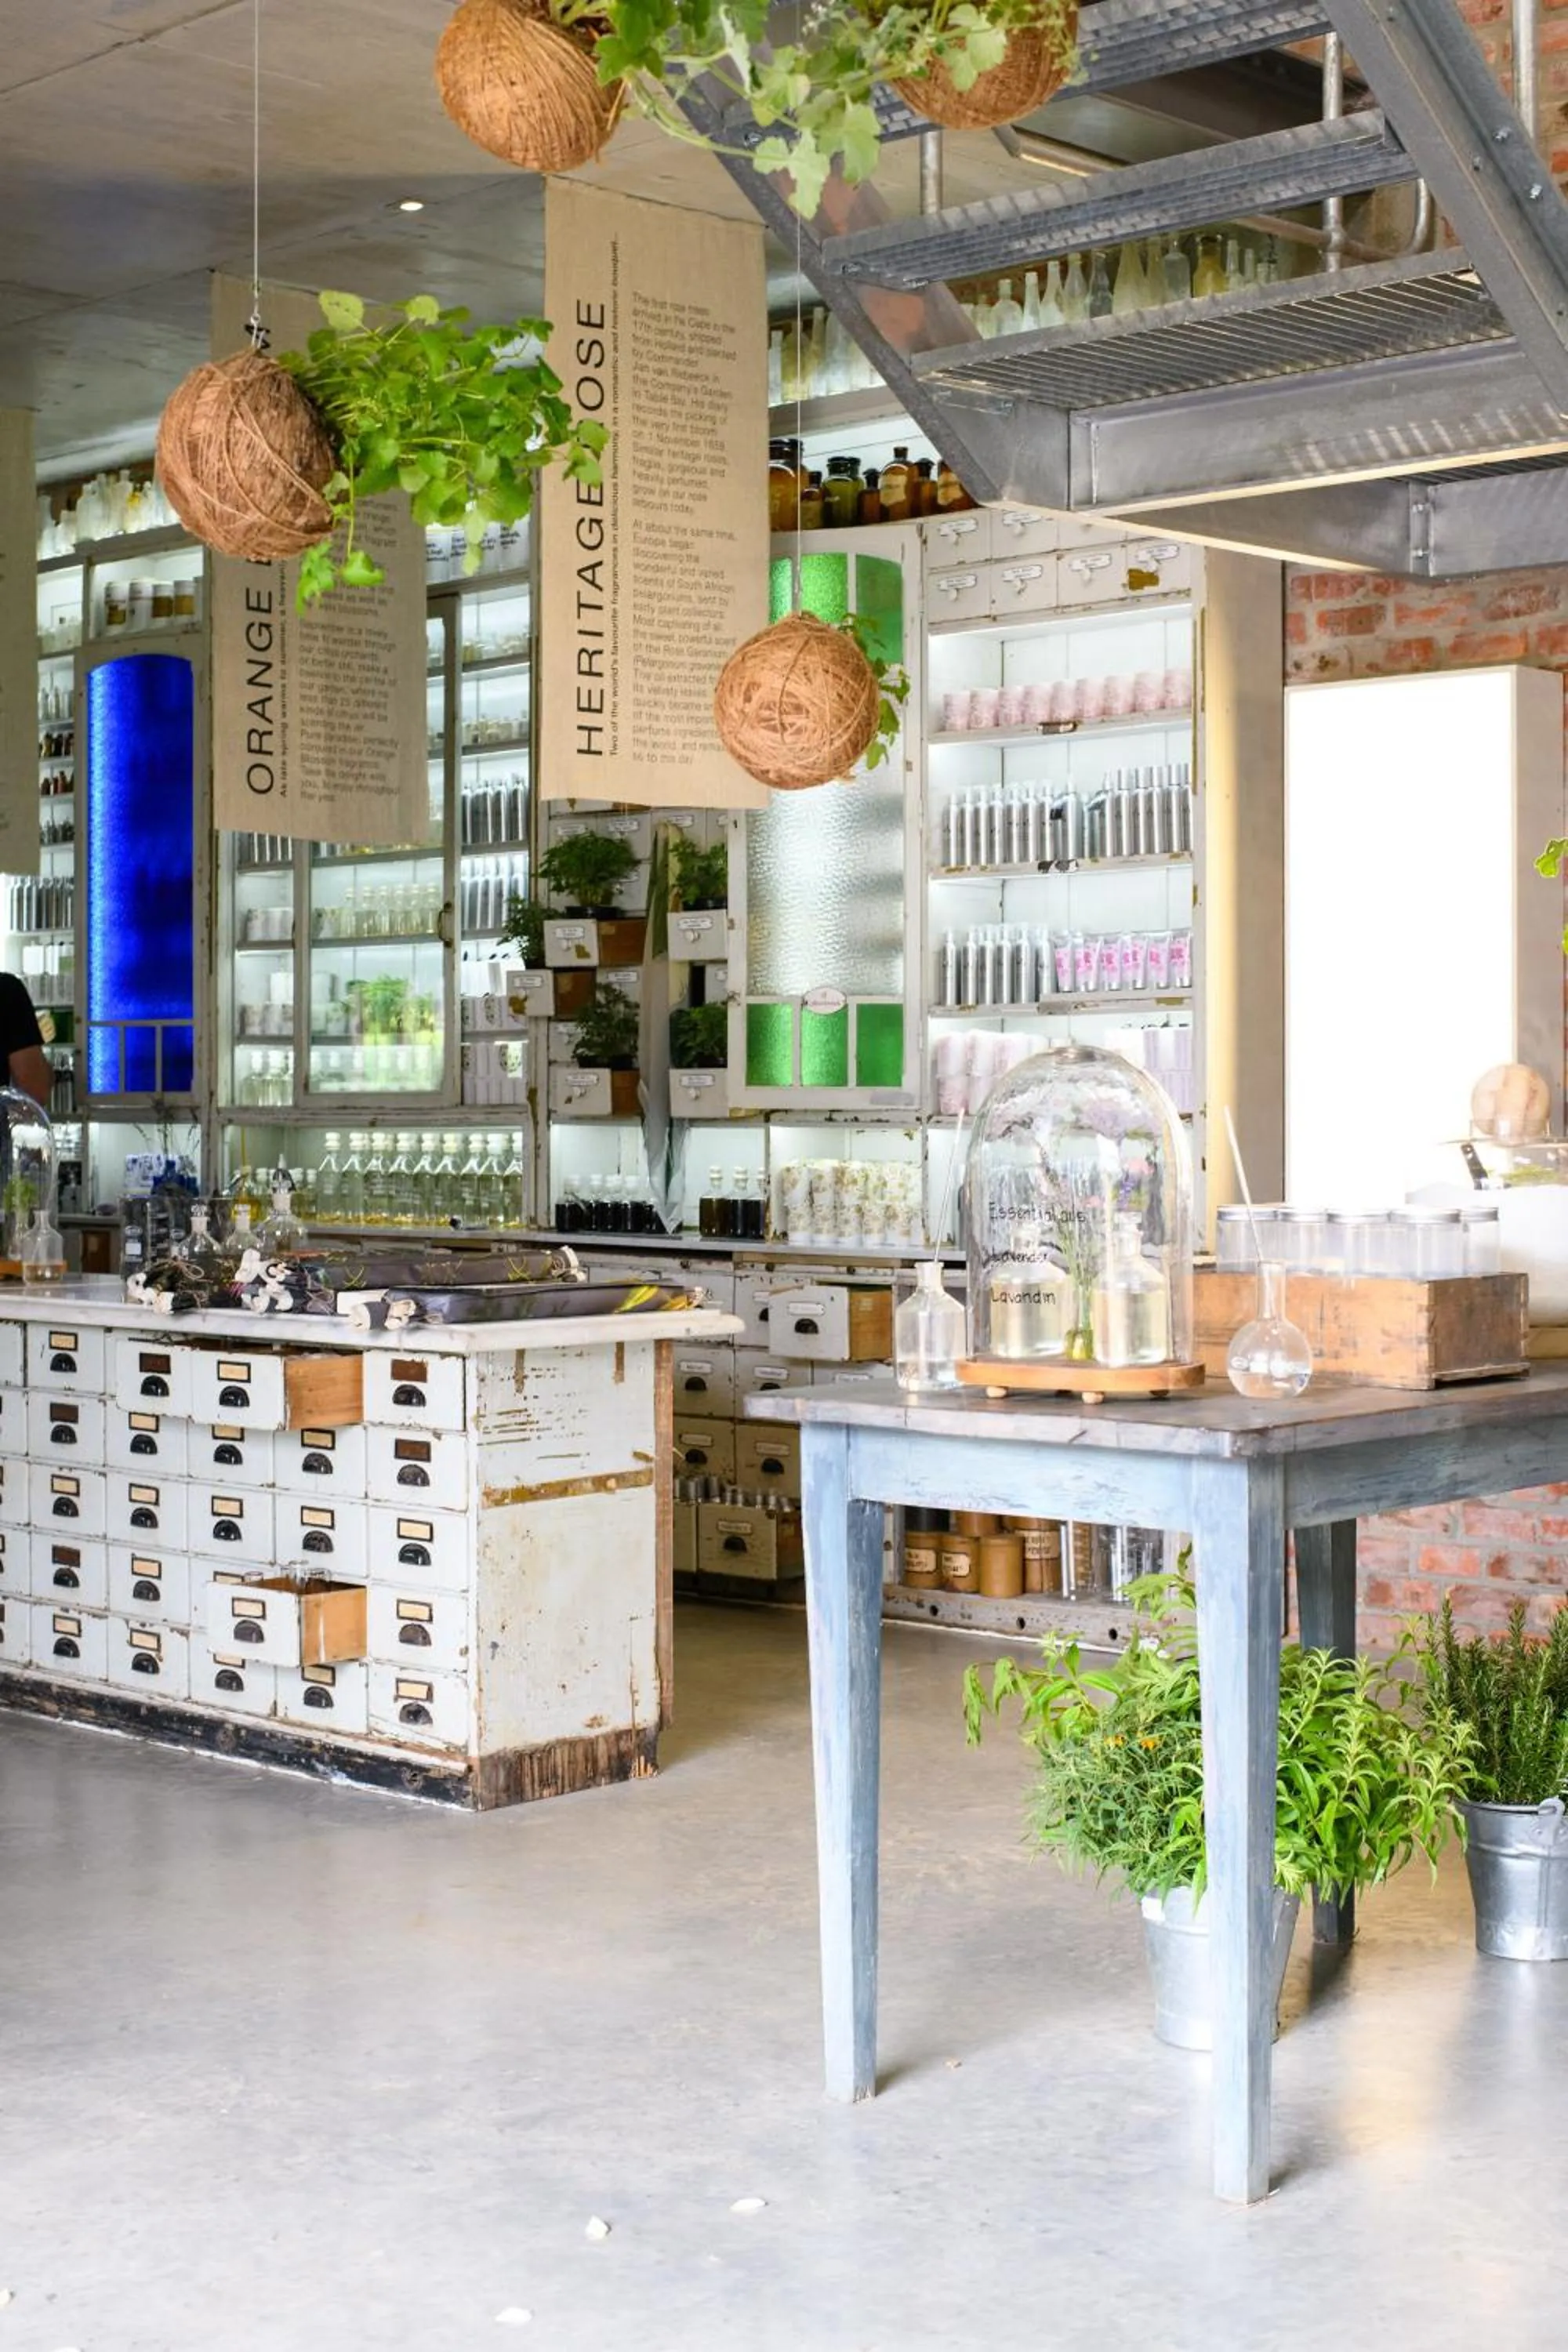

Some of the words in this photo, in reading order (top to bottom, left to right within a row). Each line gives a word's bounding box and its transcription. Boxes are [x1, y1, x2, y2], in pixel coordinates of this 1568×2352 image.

[576, 479, 604, 756] HERITAGE
[245, 587, 274, 794] ORANGE
[989, 1201, 1056, 1221] Essential
[990, 1287, 1056, 1305] Lavandin
